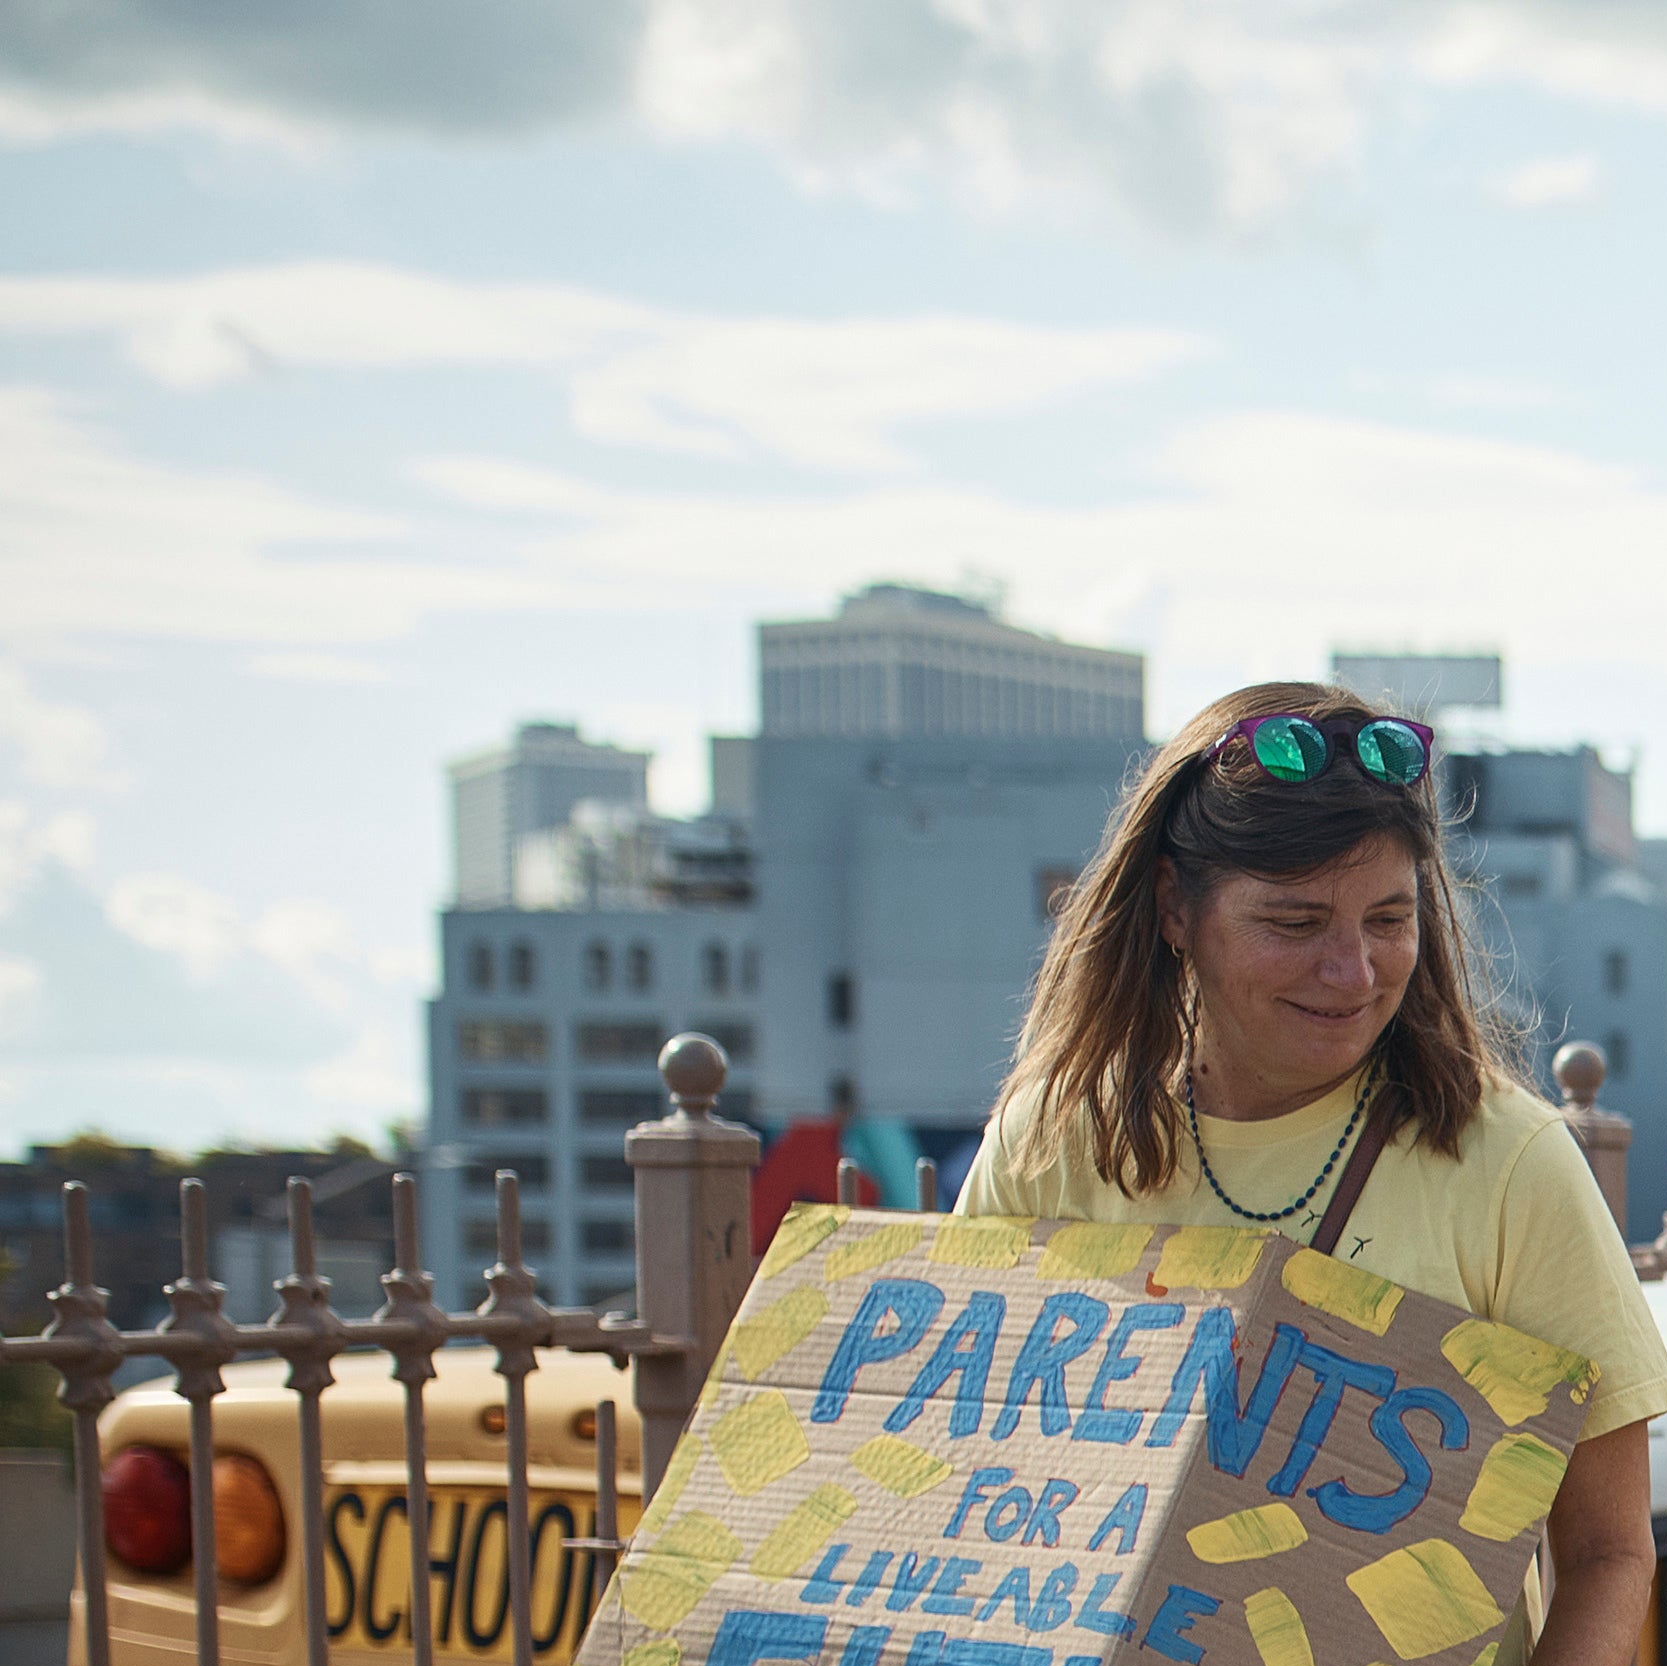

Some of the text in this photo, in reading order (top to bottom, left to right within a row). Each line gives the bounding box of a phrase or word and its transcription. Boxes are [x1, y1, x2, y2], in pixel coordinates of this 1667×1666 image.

[809, 1279, 1470, 1535] PARENTS
[327, 1491, 605, 1655] SCHOO
[942, 1466, 1148, 1556] FOR A
[800, 1542, 1222, 1665] LIVEABLE
